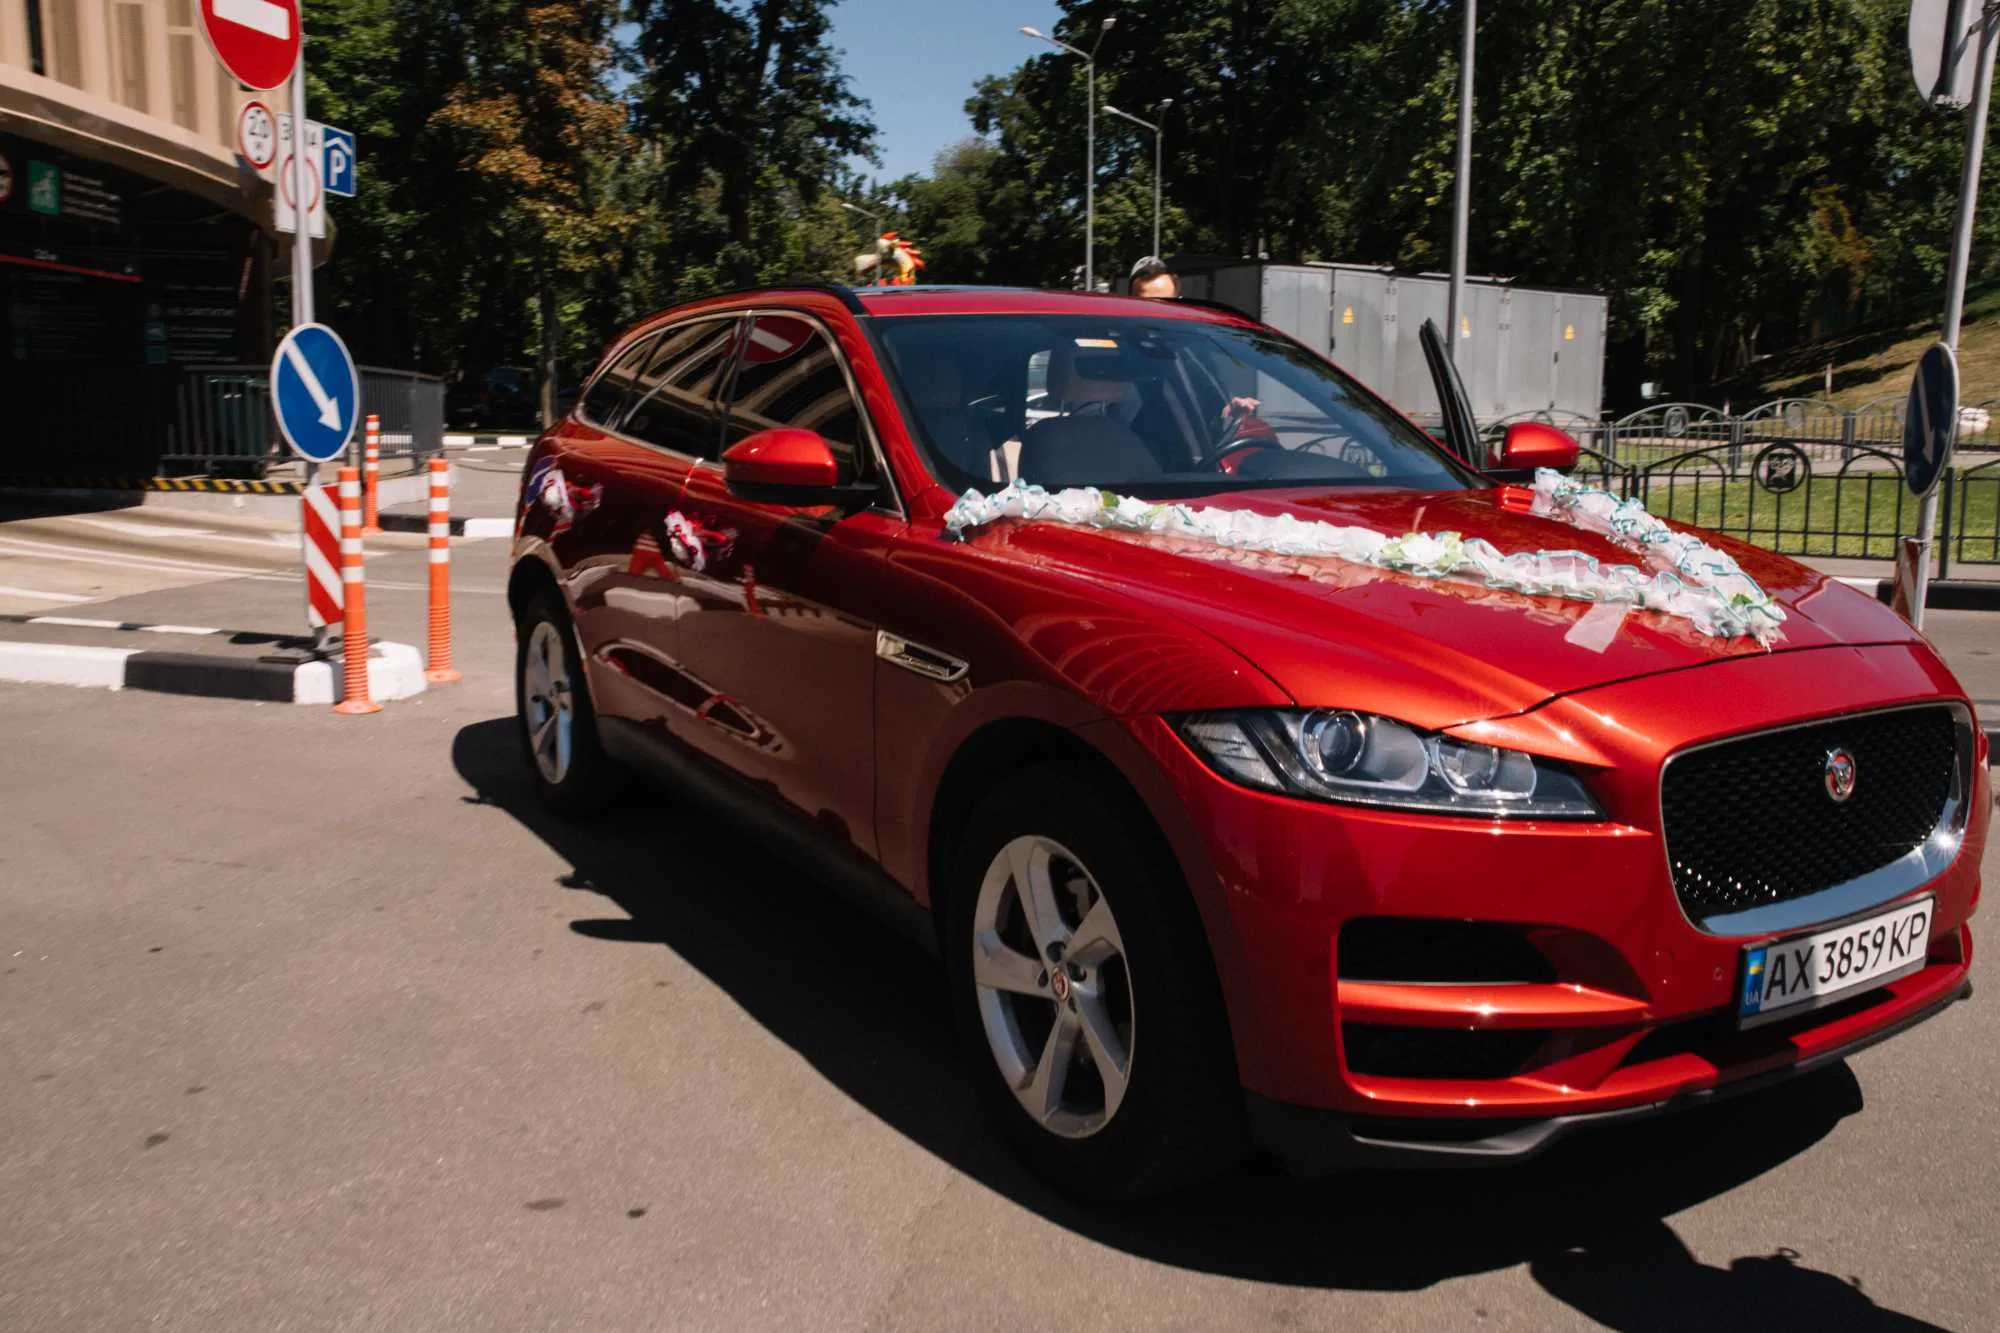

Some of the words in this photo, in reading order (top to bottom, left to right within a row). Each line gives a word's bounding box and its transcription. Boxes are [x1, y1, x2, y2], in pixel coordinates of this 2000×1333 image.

[329, 149, 346, 186] P
[1765, 946, 1815, 1000] AX
[1818, 925, 1886, 983] 3859
[1889, 911, 1926, 961] KP
[1745, 992, 1760, 1006] UA
